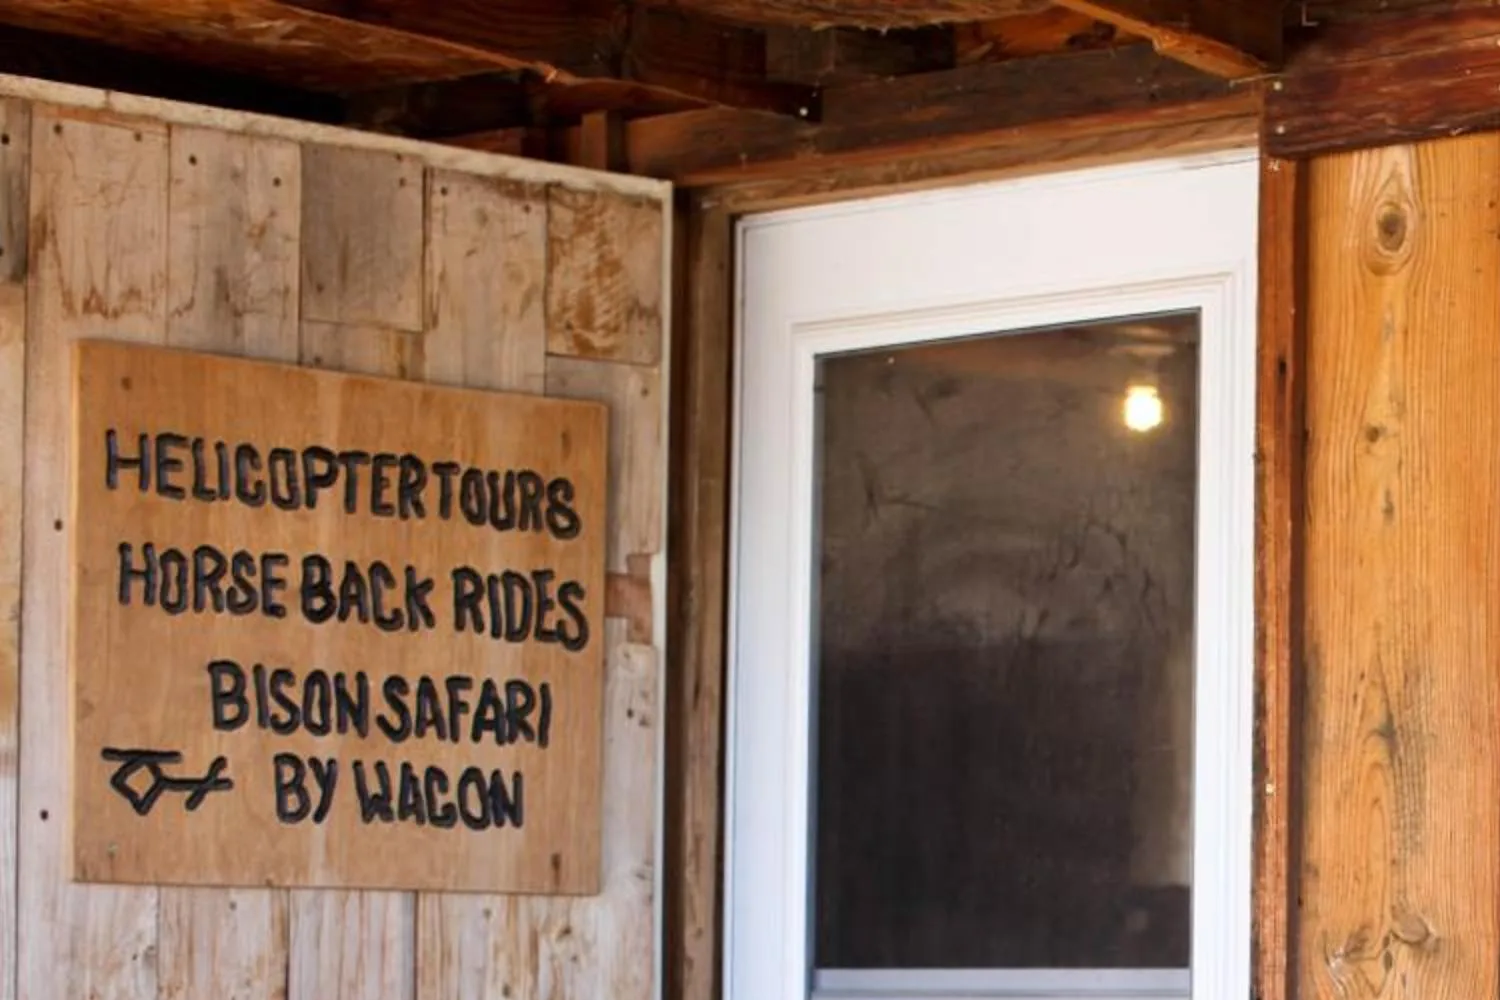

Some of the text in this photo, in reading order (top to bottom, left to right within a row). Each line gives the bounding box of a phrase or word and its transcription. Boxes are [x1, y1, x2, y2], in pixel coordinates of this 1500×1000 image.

[105, 428, 581, 539] HELICOPTER TOURS
[451, 566, 590, 652] RIDES
[207, 660, 552, 747] BISON SAFARI
[274, 752, 338, 825] BY
